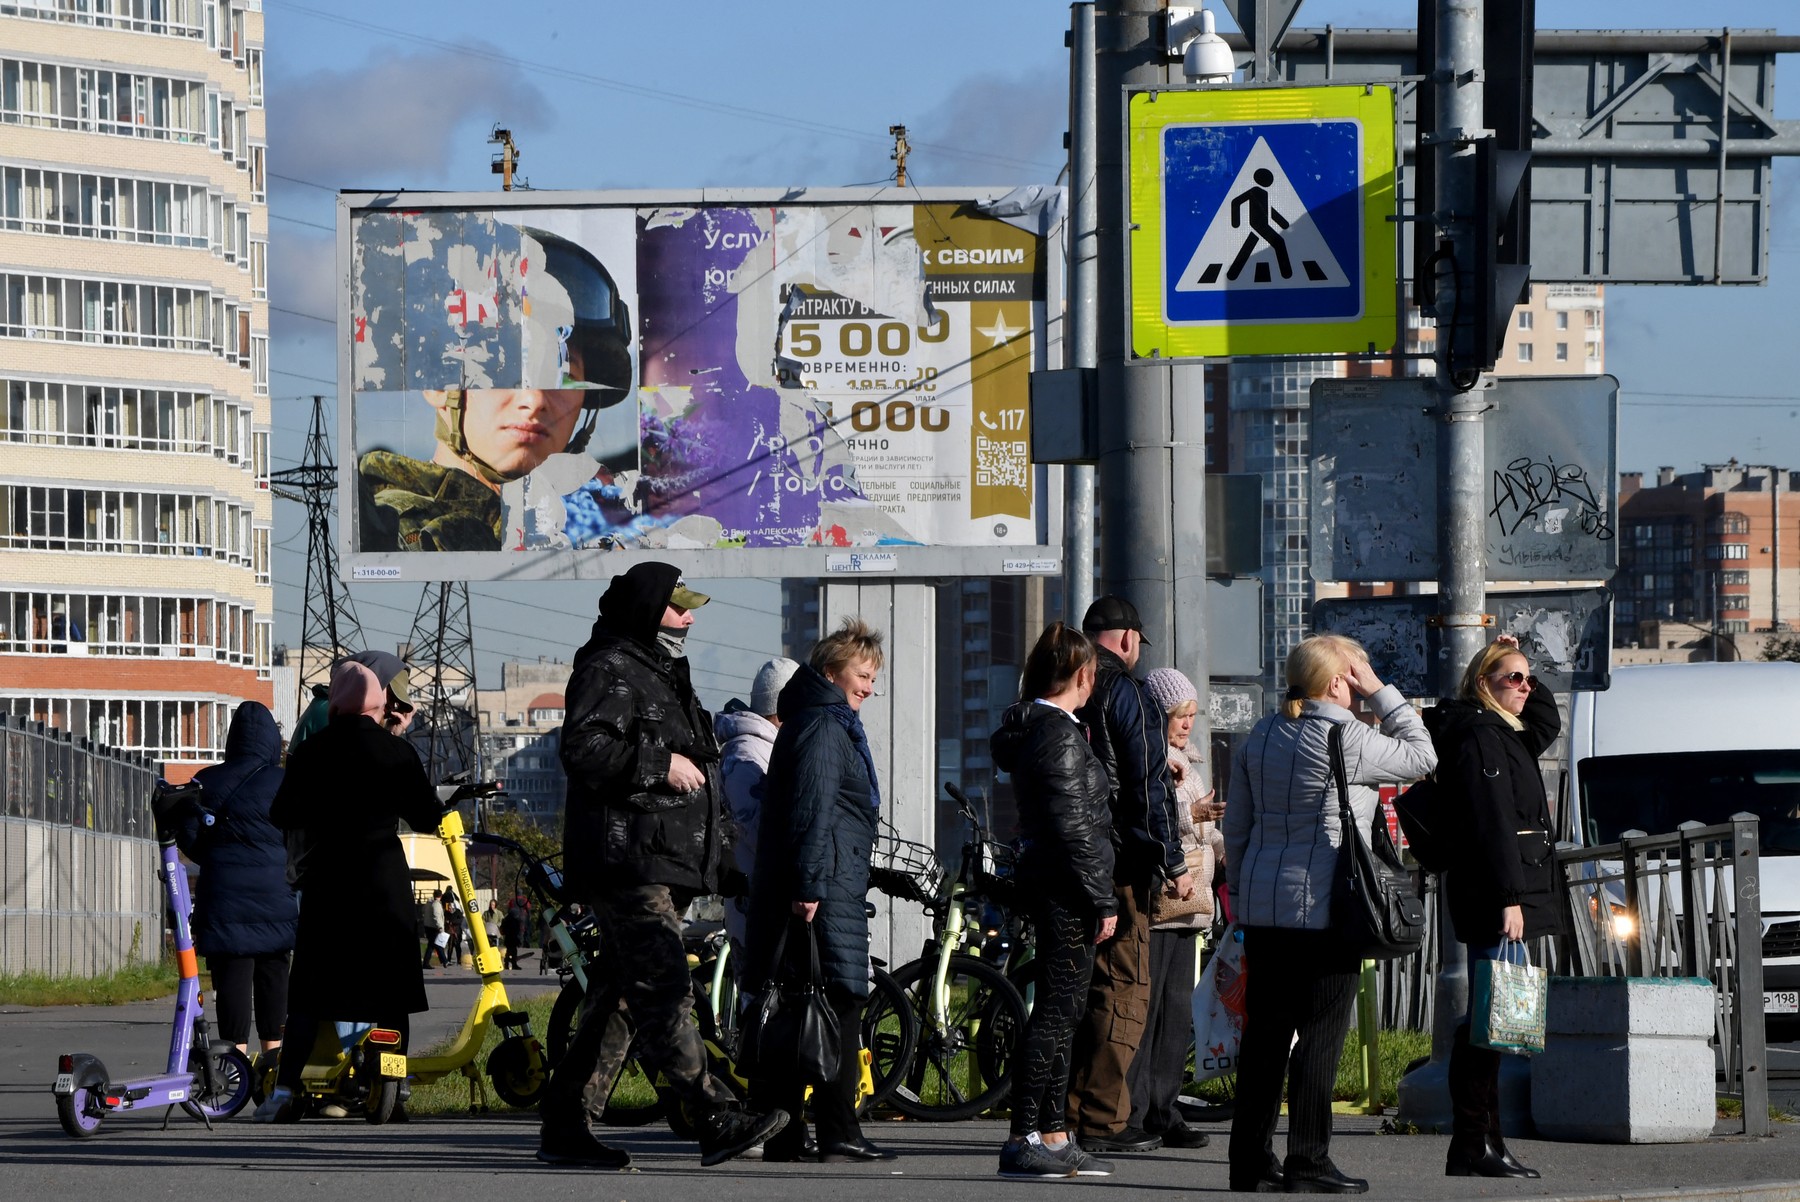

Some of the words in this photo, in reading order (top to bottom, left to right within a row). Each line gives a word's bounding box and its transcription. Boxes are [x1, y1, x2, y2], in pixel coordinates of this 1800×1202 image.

[938, 248, 1023, 265] СВОИМ
[974, 281, 1015, 293] СИЛАХ
[999, 409, 1025, 431] 117
[847, 439, 889, 451] ЯЧНО
[909, 480, 961, 491] СОЦИАЛЬНЫЕ
[907, 493, 961, 503] ПРЕДПРИЯТИЯ
[1774, 993, 1796, 1004] 198
